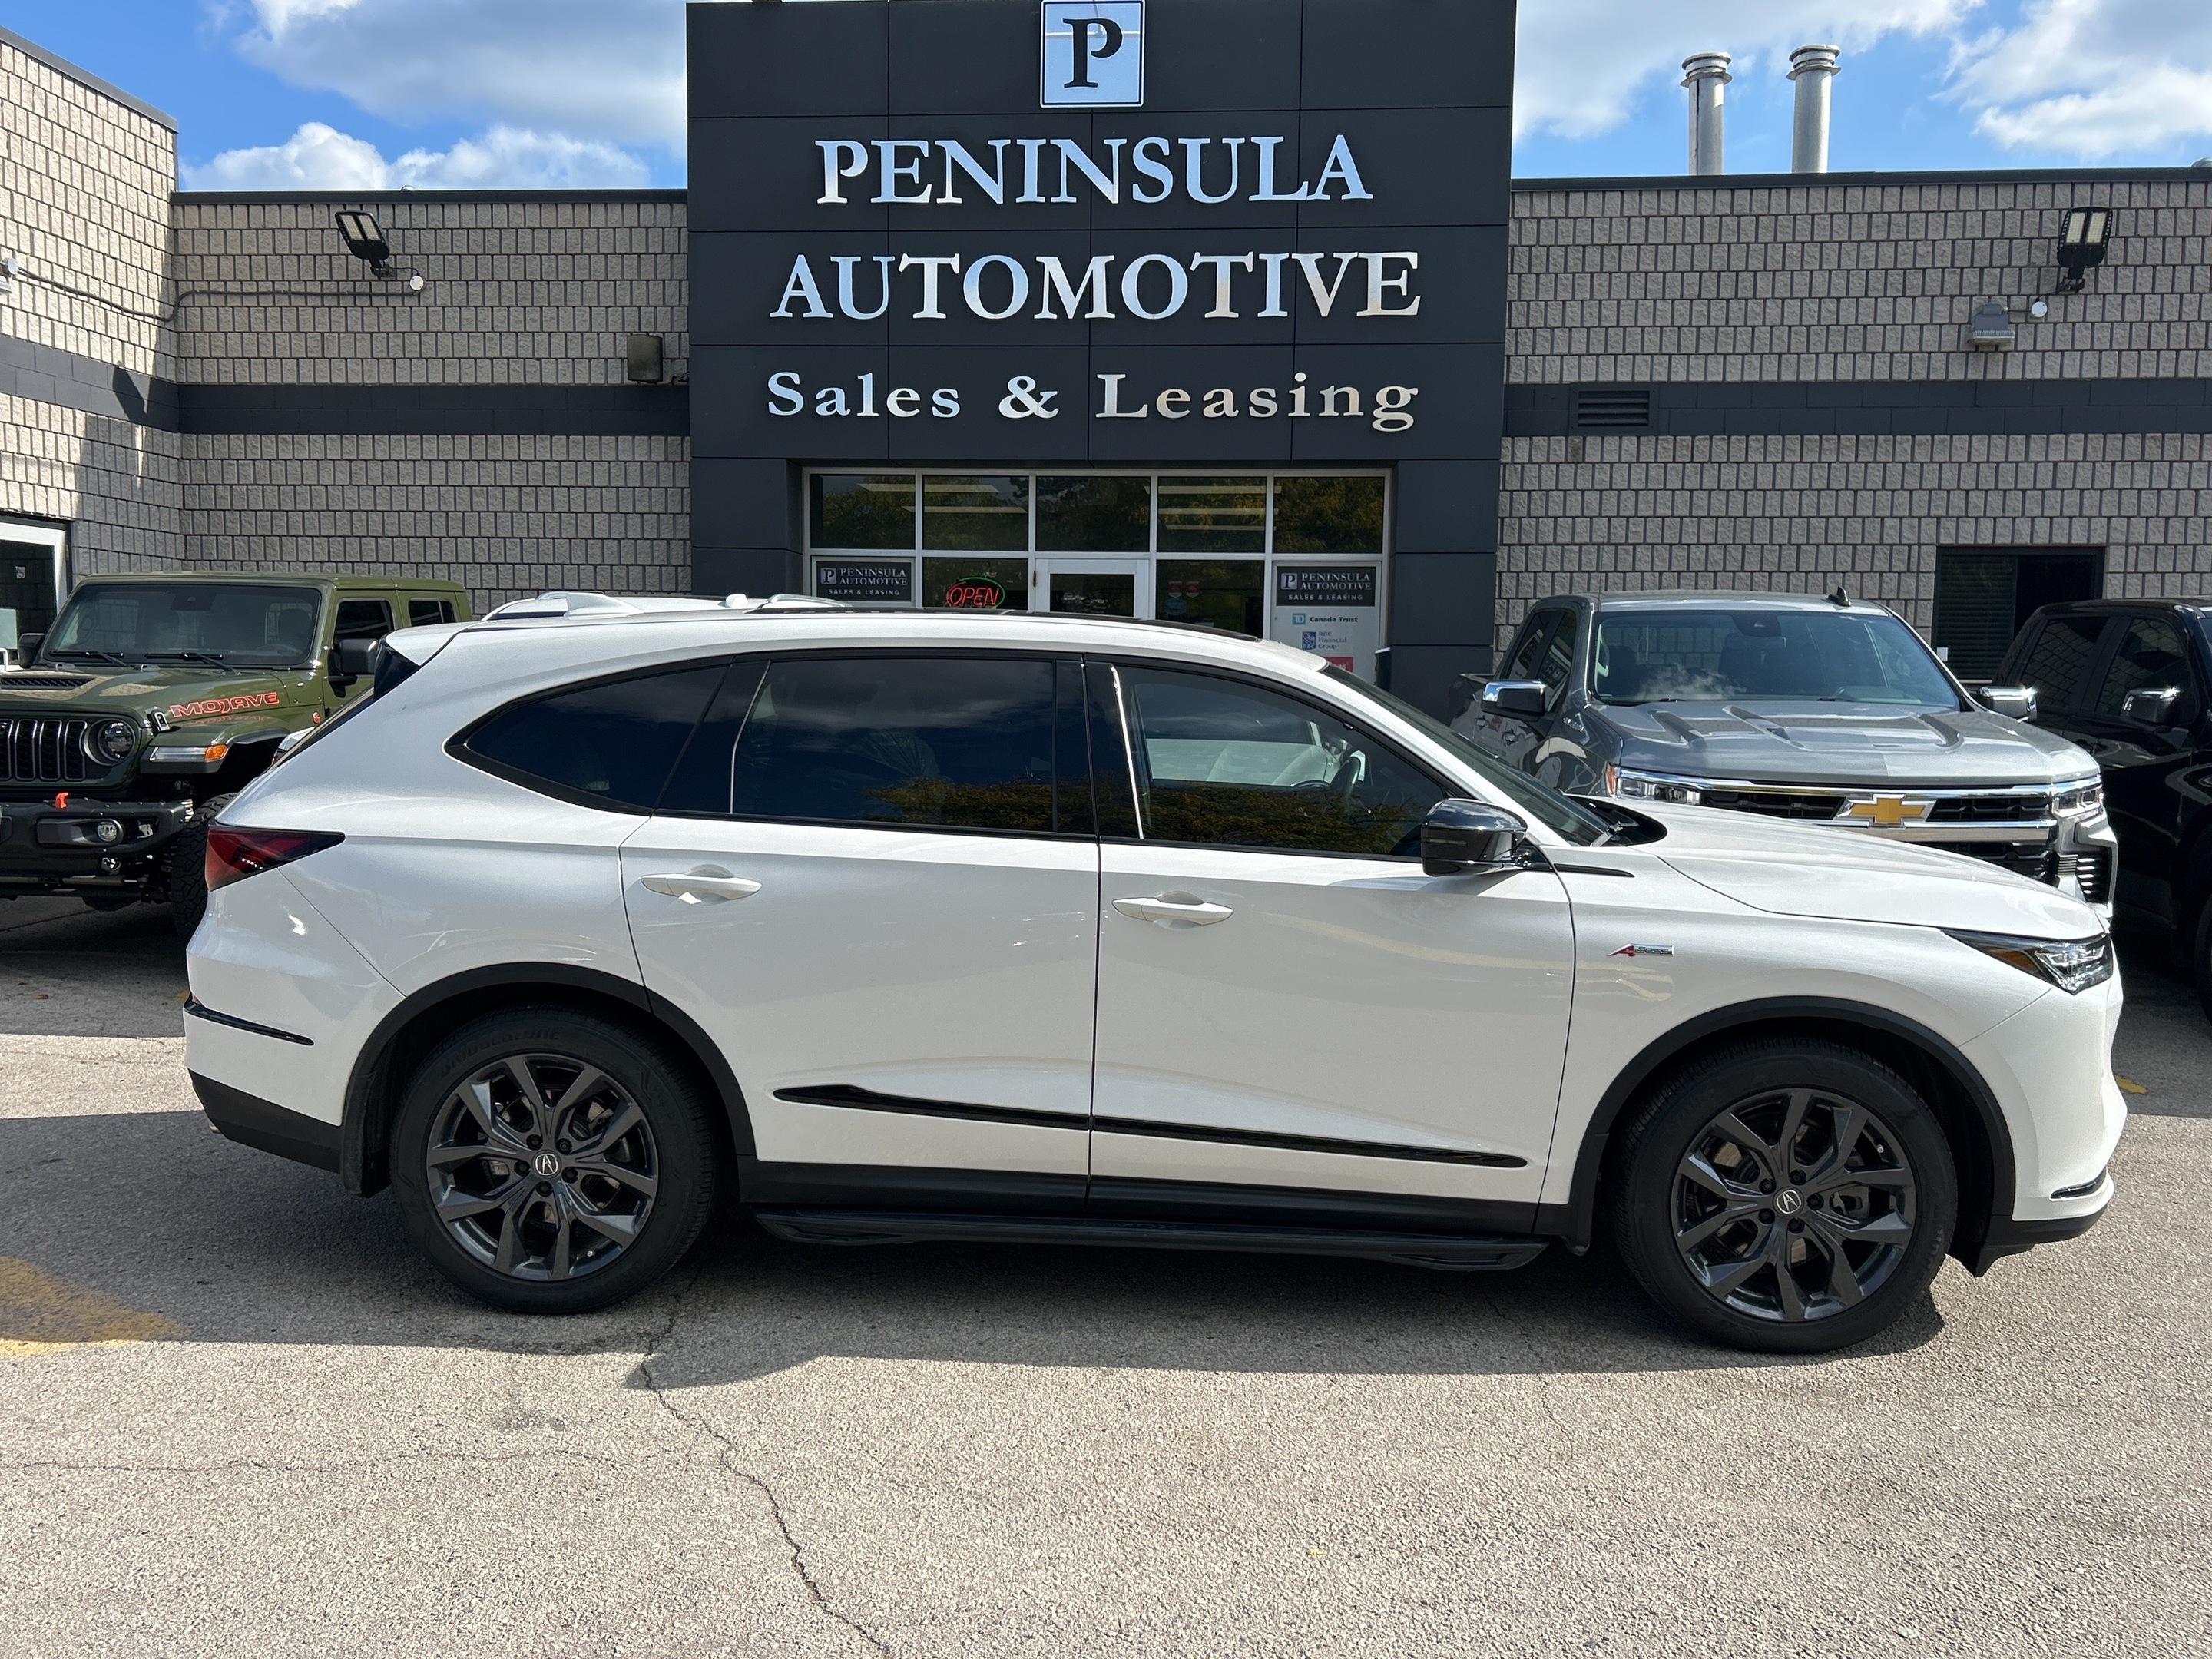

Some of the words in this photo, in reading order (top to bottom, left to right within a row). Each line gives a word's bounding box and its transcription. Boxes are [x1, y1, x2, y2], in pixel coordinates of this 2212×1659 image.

[1062, 18, 1124, 89] P
[815, 134, 1374, 205] PENINSULA
[770, 250, 1422, 320] AUTOMOTIVE
[767, 371, 961, 419] Sales
[998, 375, 1060, 419] &
[1095, 372, 1419, 432] Leasing
[823, 569, 835, 584] P
[840, 568, 906, 578] PENINSULA
[1301, 573, 1371, 582] PENINSULA
[839, 577, 908, 586] AUTOMOTIVE
[1285, 575, 1296, 589] P
[1300, 582, 1373, 591] AUTOMOTIVE
[949, 587, 1000, 606] OPEN
[1293, 614, 1305, 624] TD
[170, 692, 280, 718] MOJAVE
